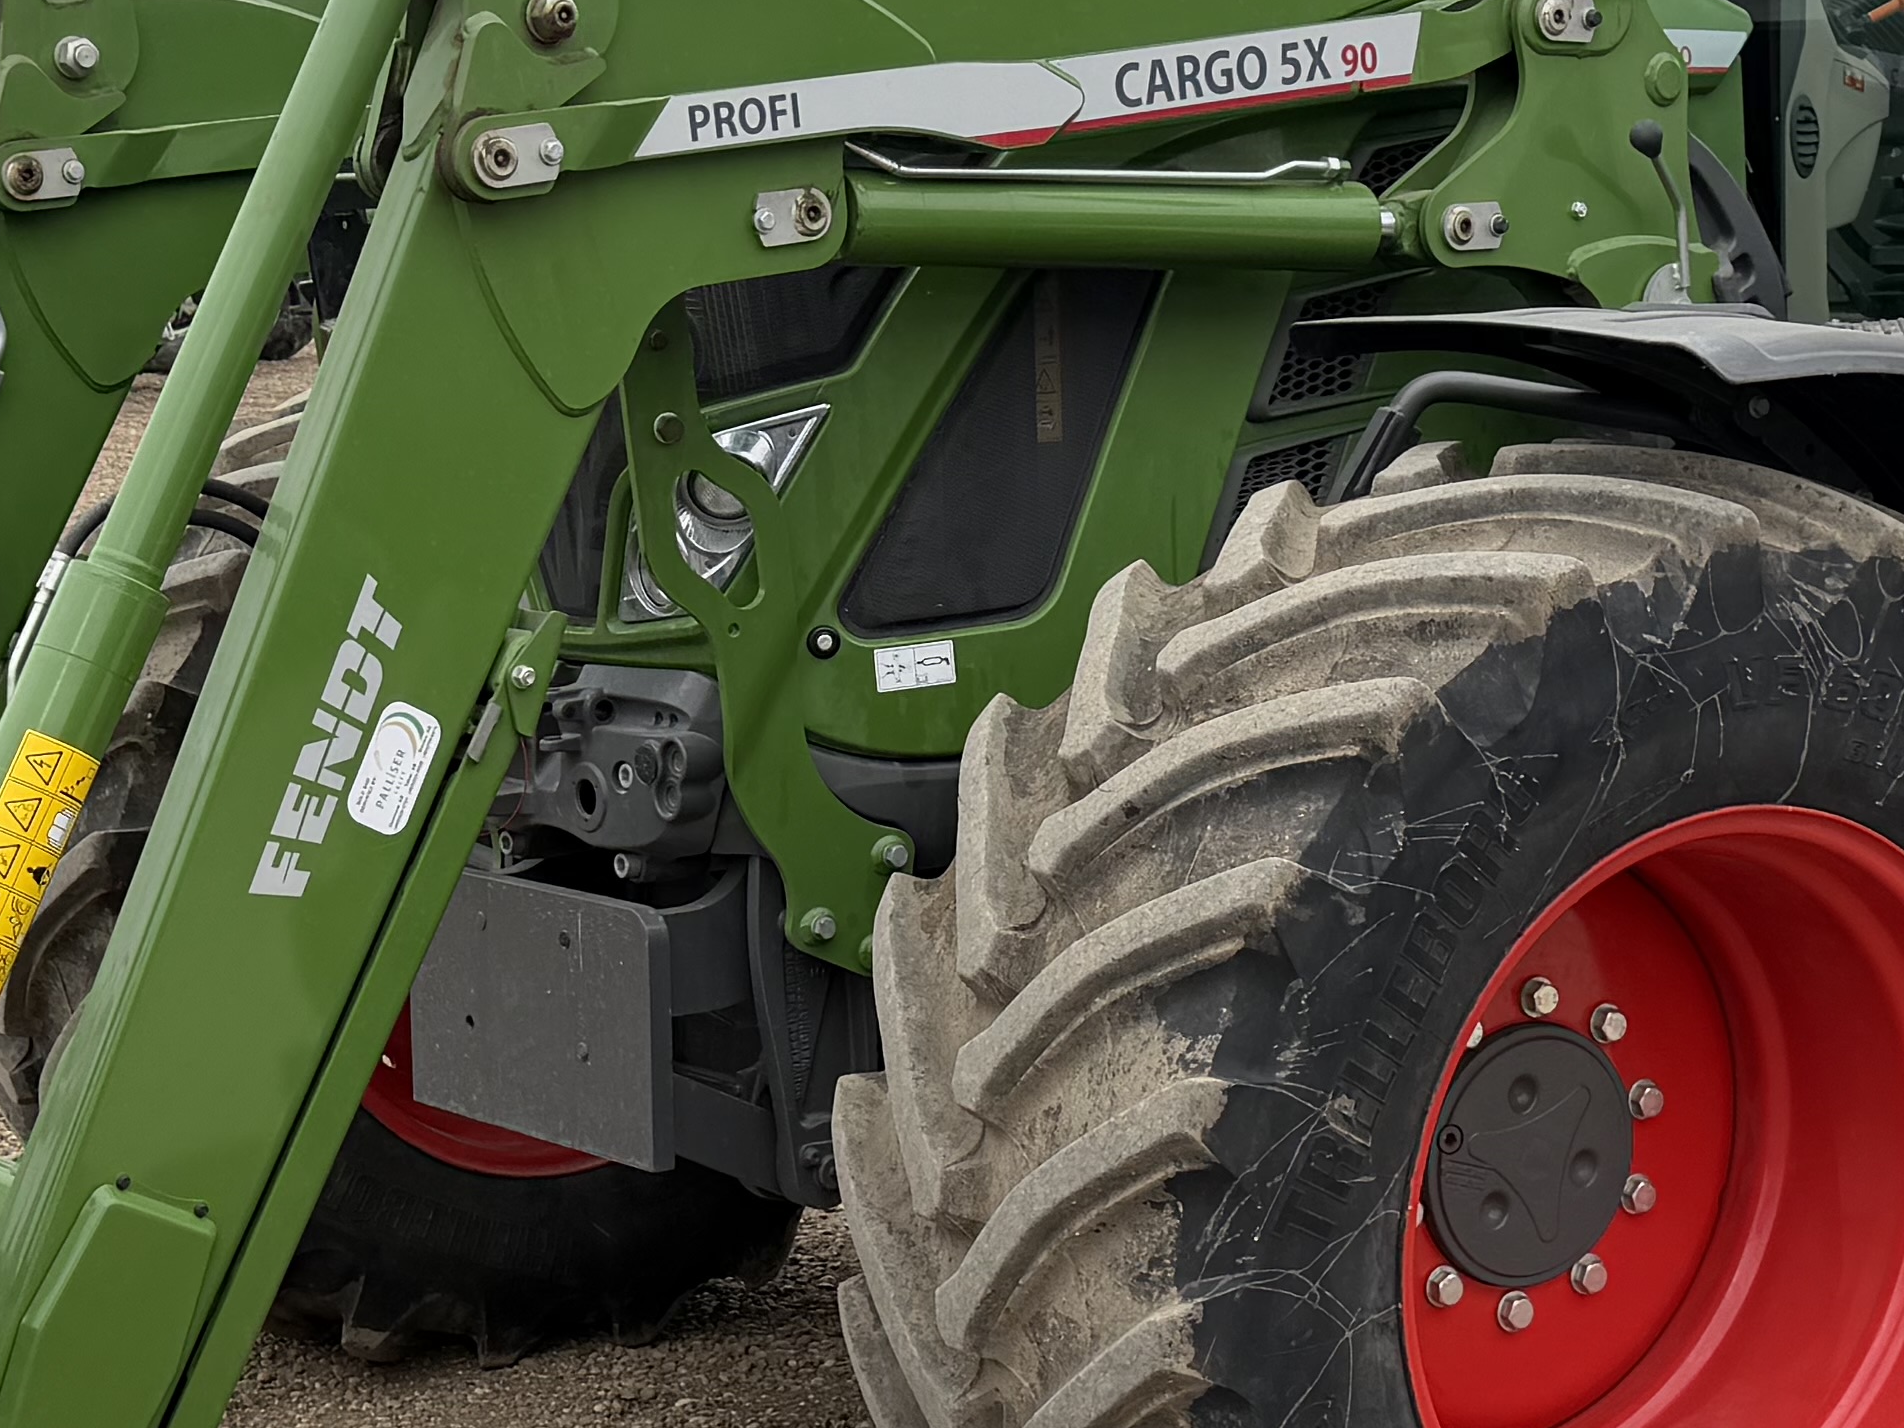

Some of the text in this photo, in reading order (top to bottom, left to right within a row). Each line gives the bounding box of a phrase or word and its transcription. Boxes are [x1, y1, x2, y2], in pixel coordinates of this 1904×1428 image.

[1115, 36, 1379, 108] CARGO 5X 90
[688, 92, 801, 142] PROFI
[248, 573, 403, 898] FENDT
[375, 748, 406, 810] PALLISER
